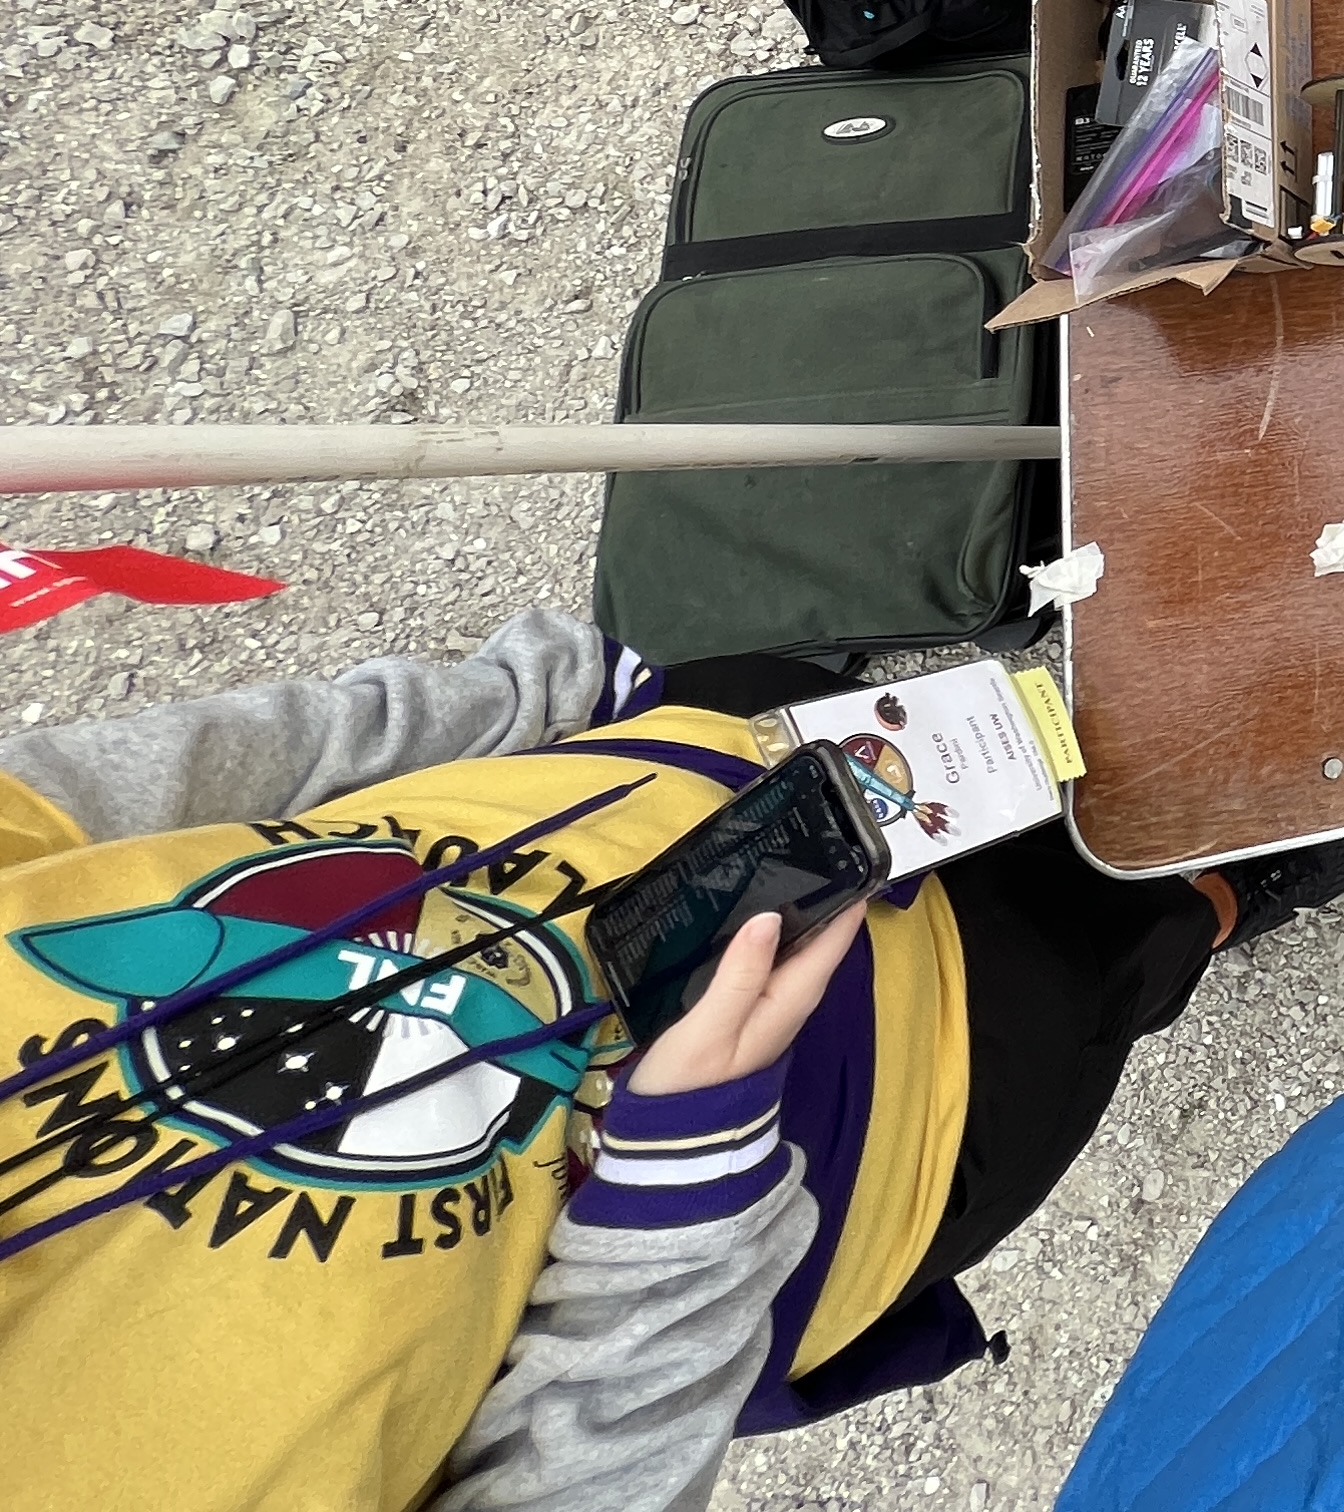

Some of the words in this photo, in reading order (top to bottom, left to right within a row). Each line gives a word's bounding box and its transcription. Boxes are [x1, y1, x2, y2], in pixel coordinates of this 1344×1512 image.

[1138, 38, 1155, 73] YEARS
[1135, 74, 1149, 86] 12
[989, 713, 1004, 731] UW
[1034, 681, 1073, 764] PARTICIPANT
[931, 732, 960, 784] Grace
[966, 715, 998, 774] Participant
[997, 729, 1017, 761] AISES
